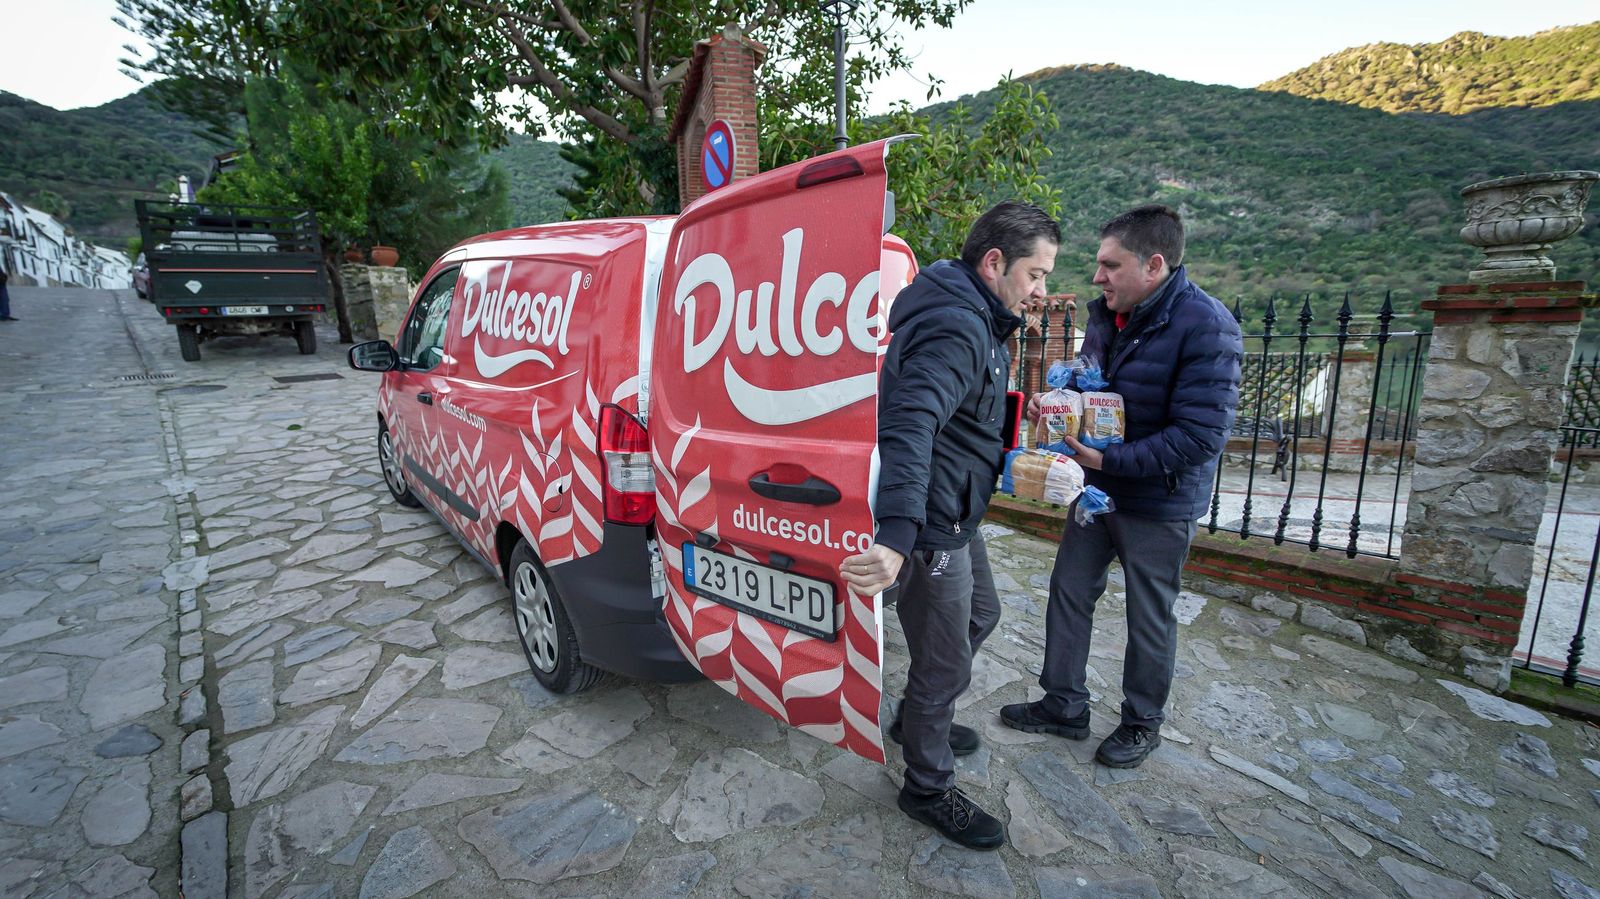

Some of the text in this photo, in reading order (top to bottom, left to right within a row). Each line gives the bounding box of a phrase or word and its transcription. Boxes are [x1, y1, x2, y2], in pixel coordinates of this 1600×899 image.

[461, 261, 582, 355] Dulcesol
[441, 395, 487, 433] dulcesol.com
[700, 556, 825, 622] 2319 LPD
